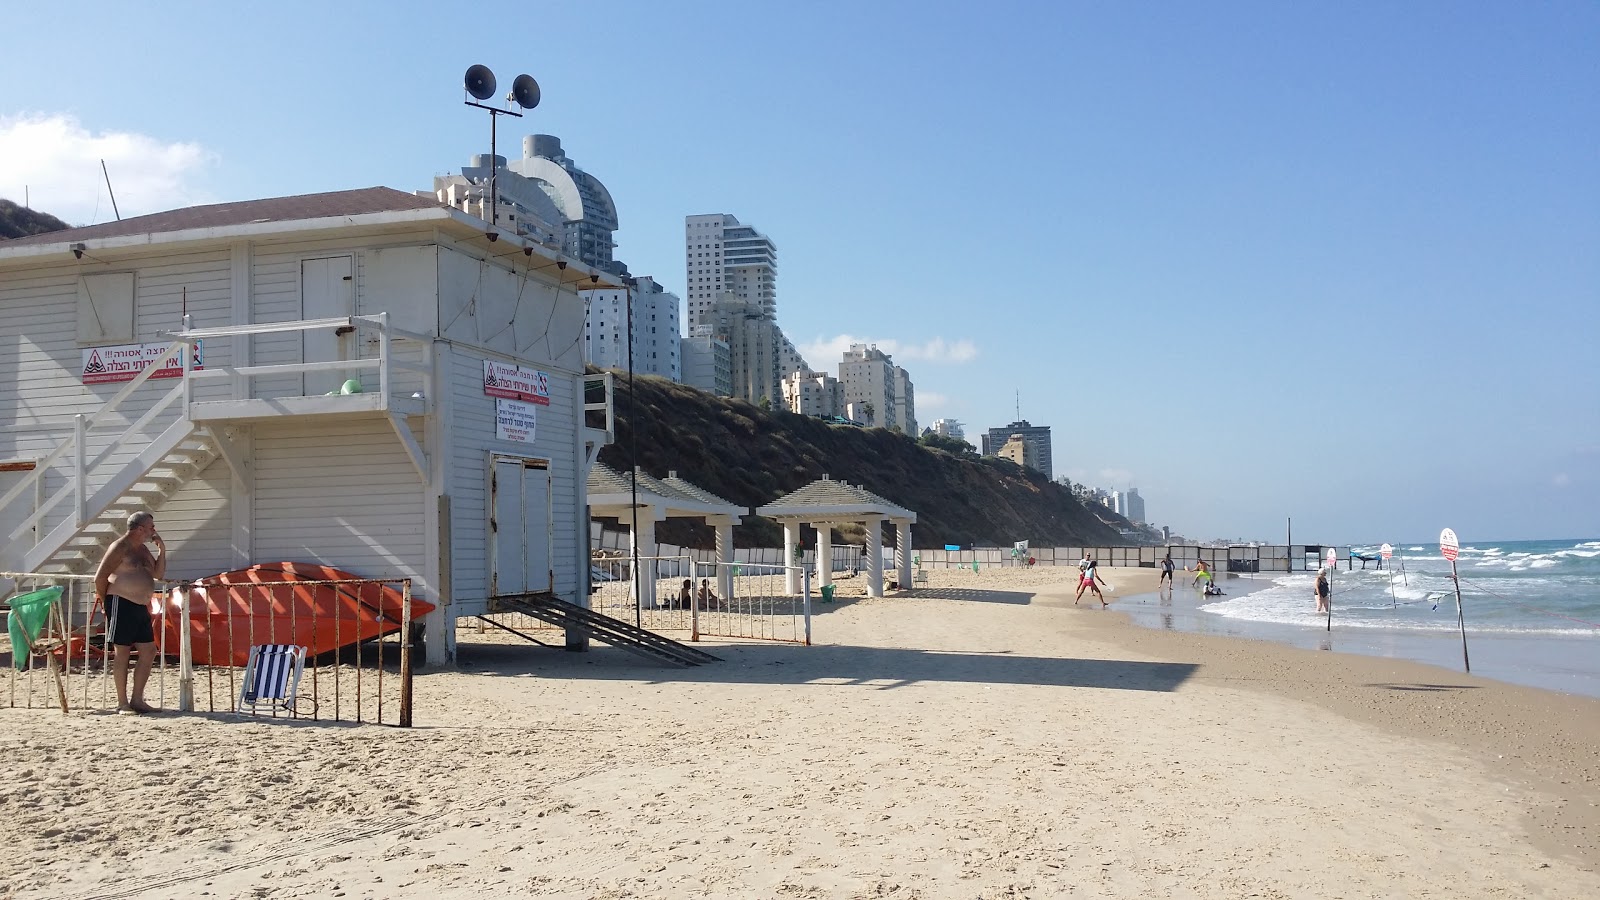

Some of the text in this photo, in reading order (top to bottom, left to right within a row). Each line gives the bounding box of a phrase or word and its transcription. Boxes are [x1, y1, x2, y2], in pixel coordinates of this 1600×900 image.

[107, 360, 130, 371] הצלה
[165, 357, 179, 369] אין
[498, 376, 513, 388] הצלה
[513, 380, 530, 392] שירותי
[530, 384, 538, 394] אין
